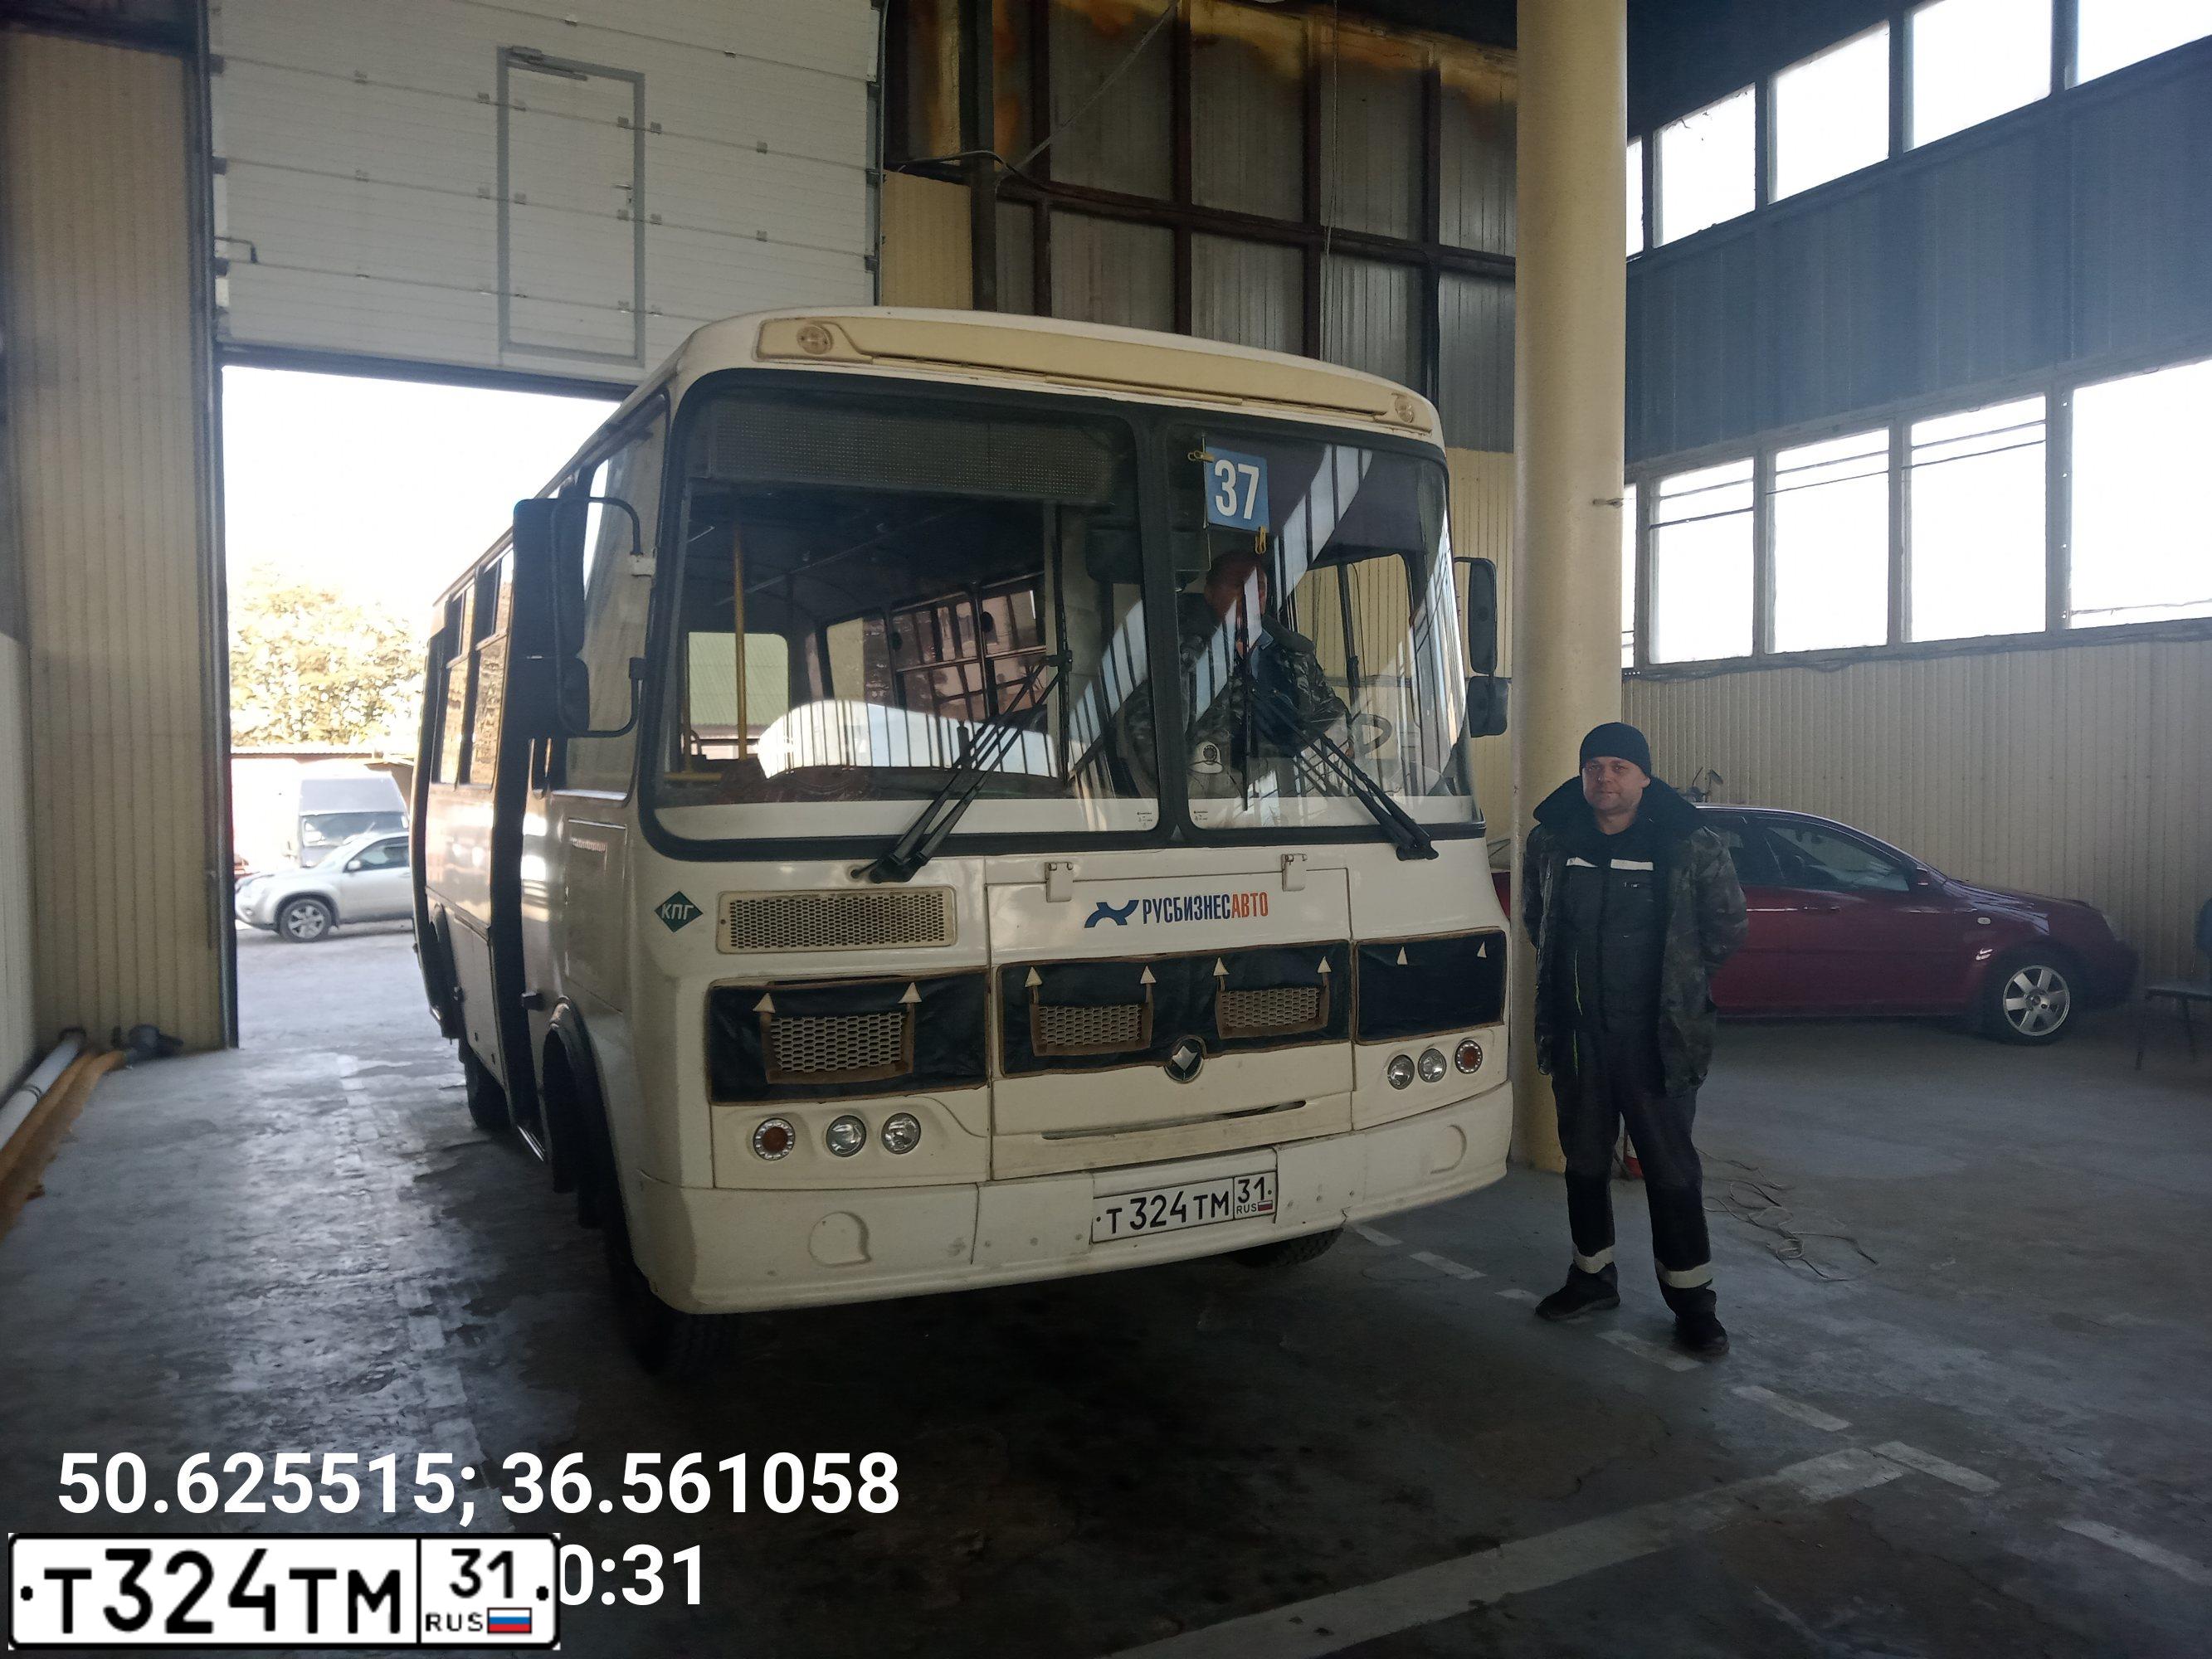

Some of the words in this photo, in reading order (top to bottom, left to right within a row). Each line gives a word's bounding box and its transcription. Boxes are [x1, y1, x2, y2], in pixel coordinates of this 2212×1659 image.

[1215, 459, 1259, 520] 37
[661, 903, 694, 921] КПГ
[1142, 891, 1269, 925] РУСБИЗНЕСАВТО
[1237, 1176, 1264, 1204] 31
[1236, 1203, 1257, 1214] RUS
